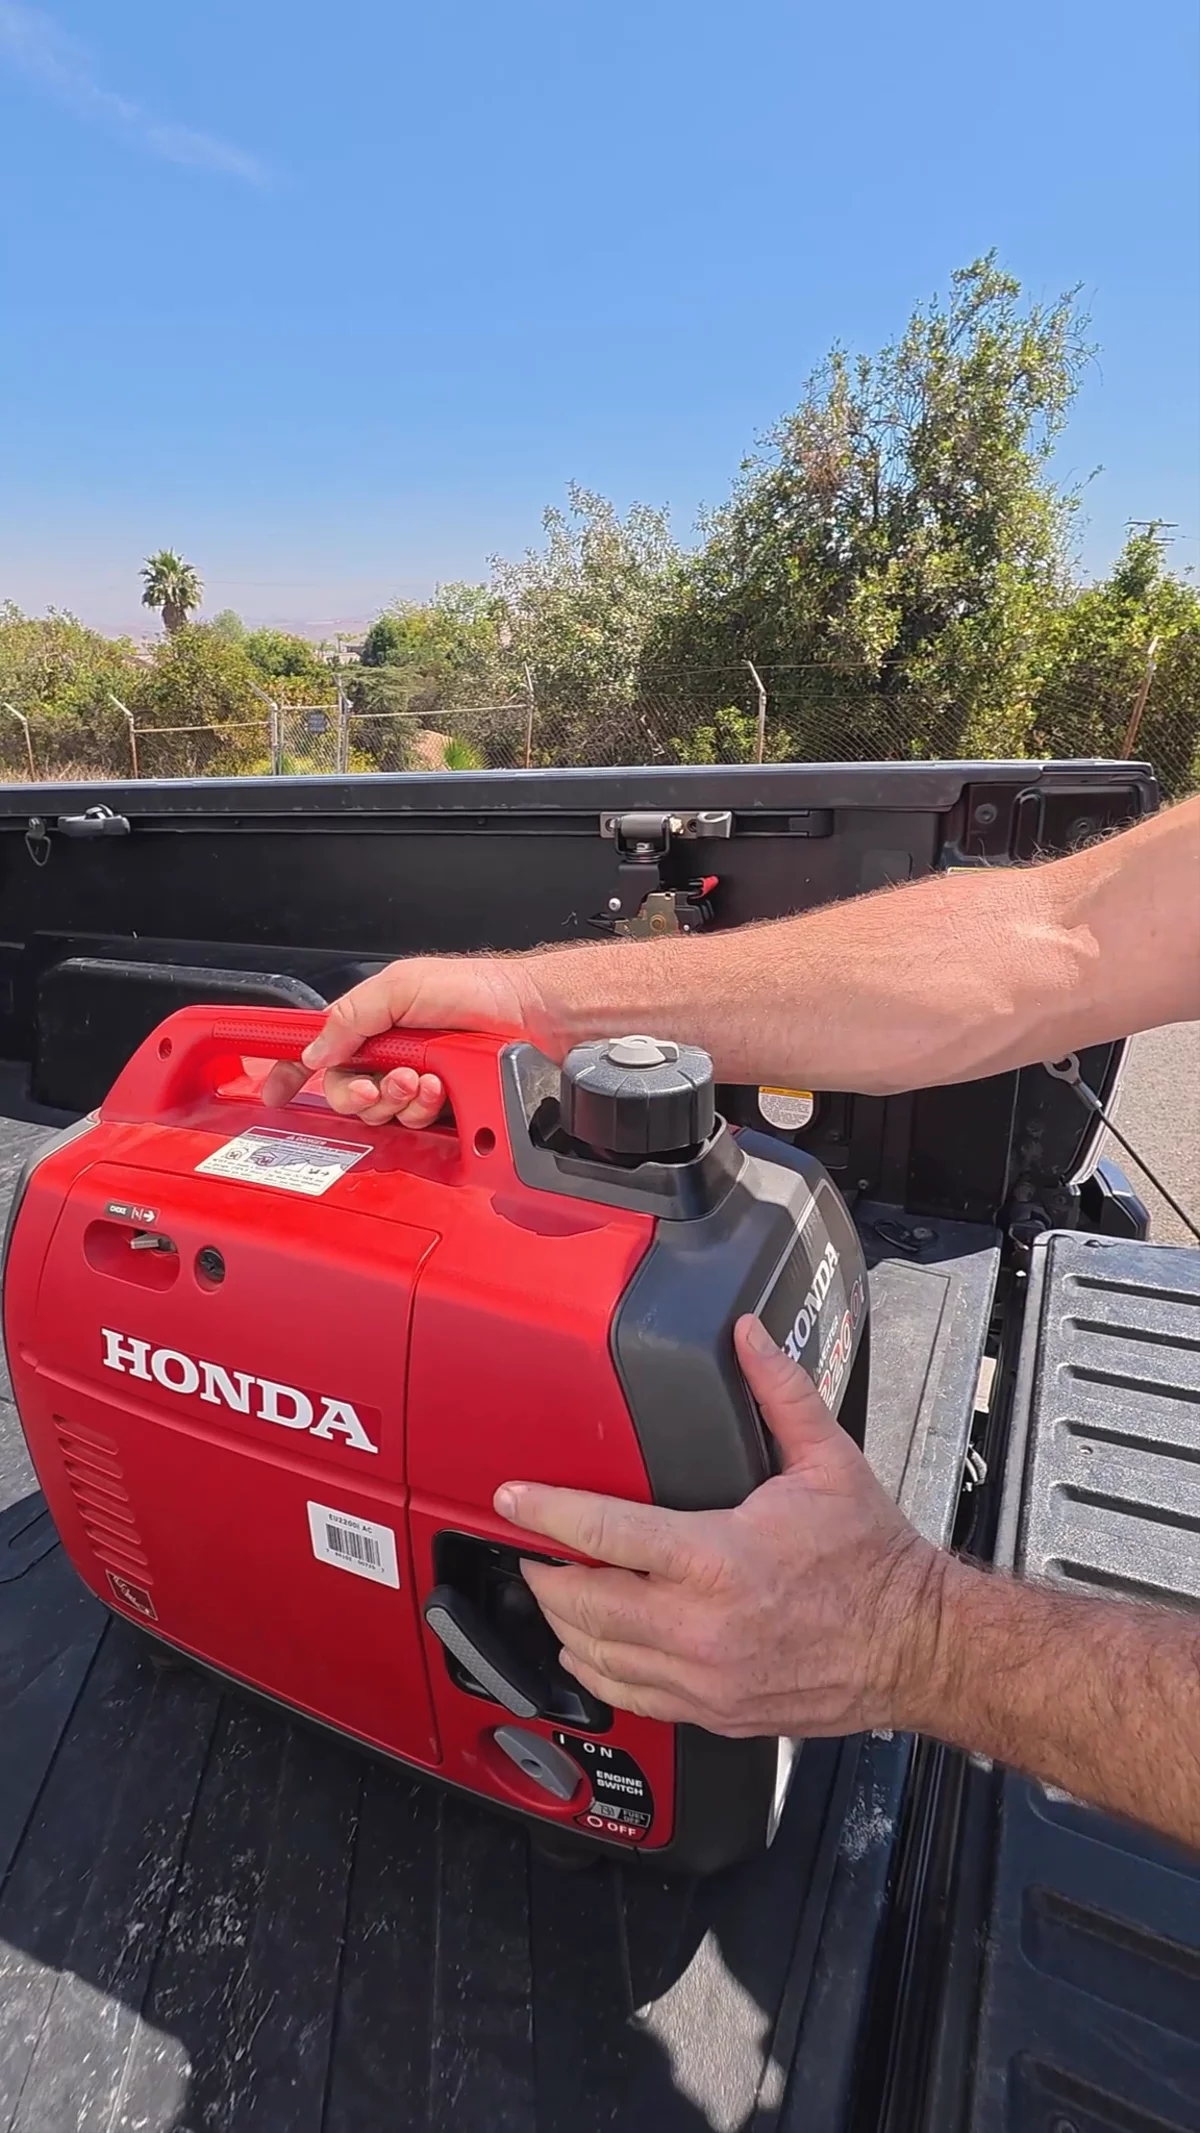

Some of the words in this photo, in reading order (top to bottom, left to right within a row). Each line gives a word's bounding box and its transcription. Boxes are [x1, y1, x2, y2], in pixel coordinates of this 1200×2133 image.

[781, 1241, 838, 1362] HONDA
[102, 1328, 378, 1454] HONDA
[362, 1525, 372, 1533] AC
[583, 1742, 613, 1758] ON
[596, 1770, 643, 1788] ENGINE
[597, 1779, 644, 1796] SWITCH
[607, 1822, 637, 1836] OFF
